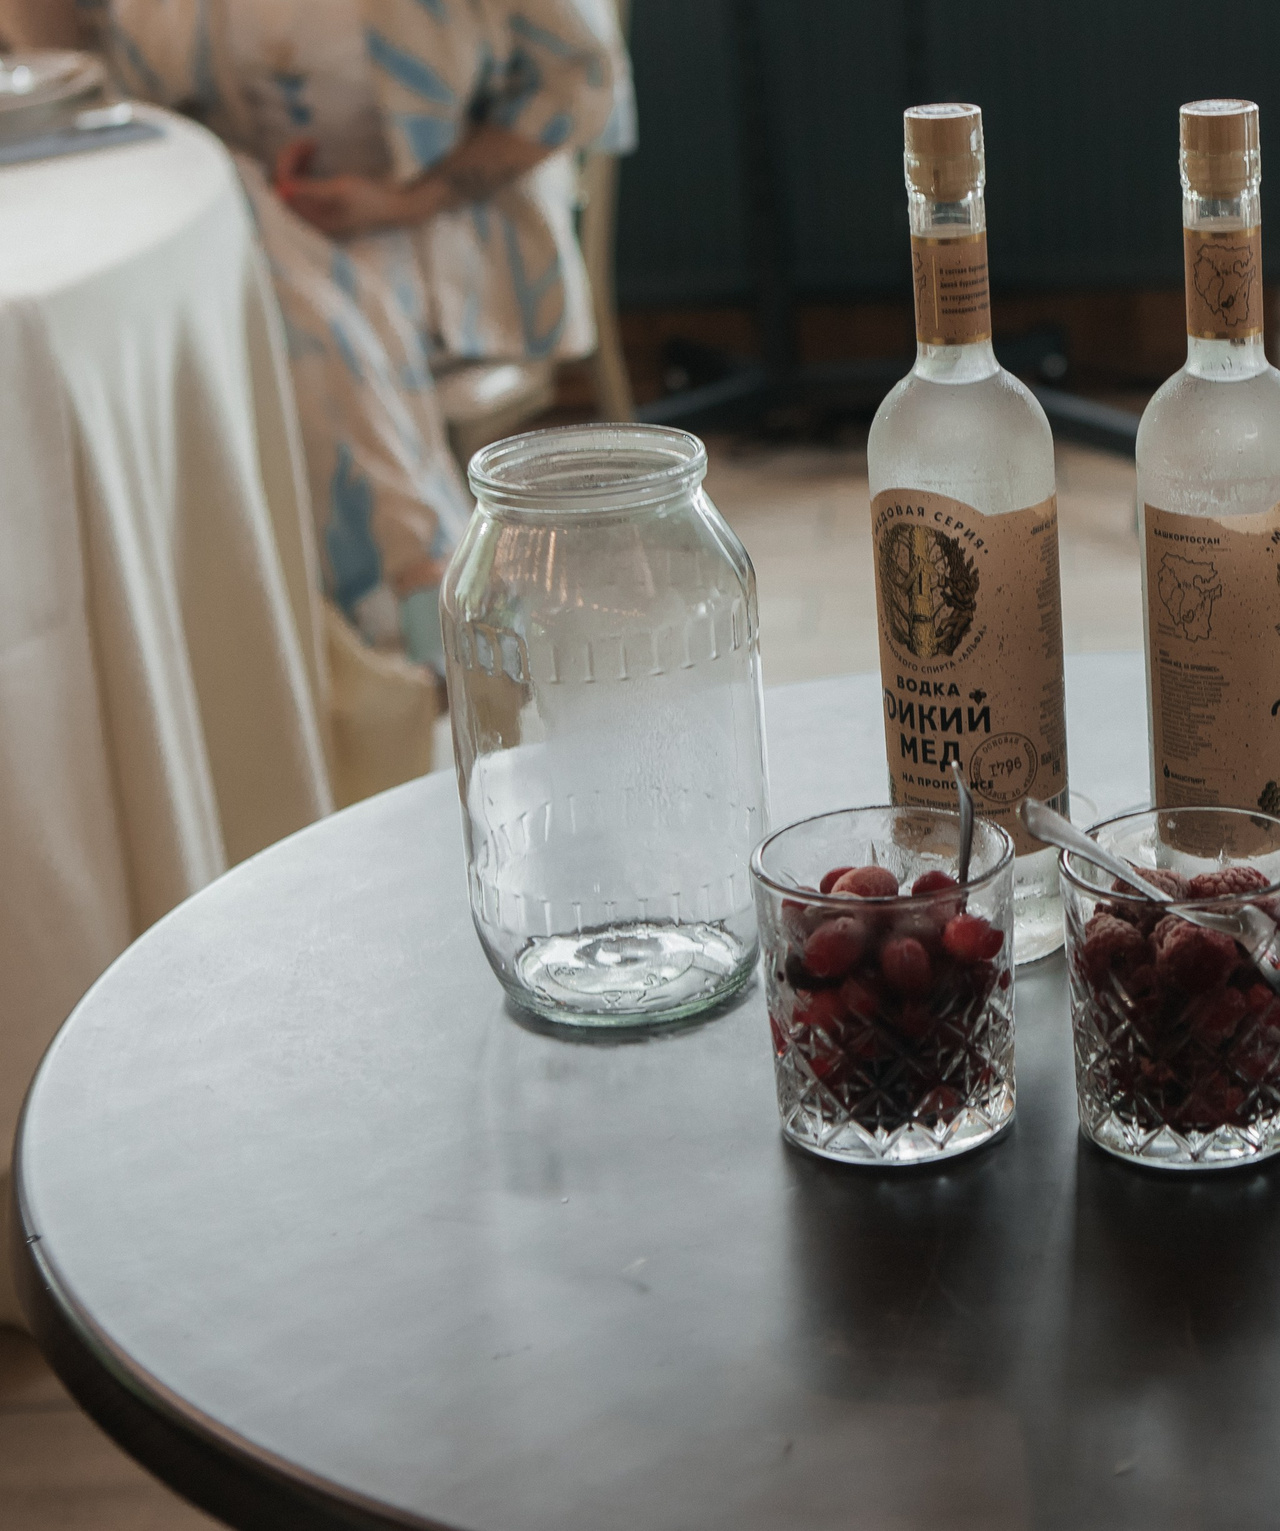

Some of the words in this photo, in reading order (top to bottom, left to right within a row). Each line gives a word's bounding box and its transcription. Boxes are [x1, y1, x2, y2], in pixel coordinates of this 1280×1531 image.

[933, 512, 985, 549] СЕРИЯ
[1154, 528, 1220, 545] БАШКОРТОСТАН
[920, 660, 956, 675] СПИРТА
[896, 674, 960, 697] ВОДКА
[884, 689, 991, 734] ДИКИЙ
[900, 733, 963, 772] МЕД
[902, 772, 915, 784] НА
[917, 775, 994, 790] ПРОПОИСЕ
